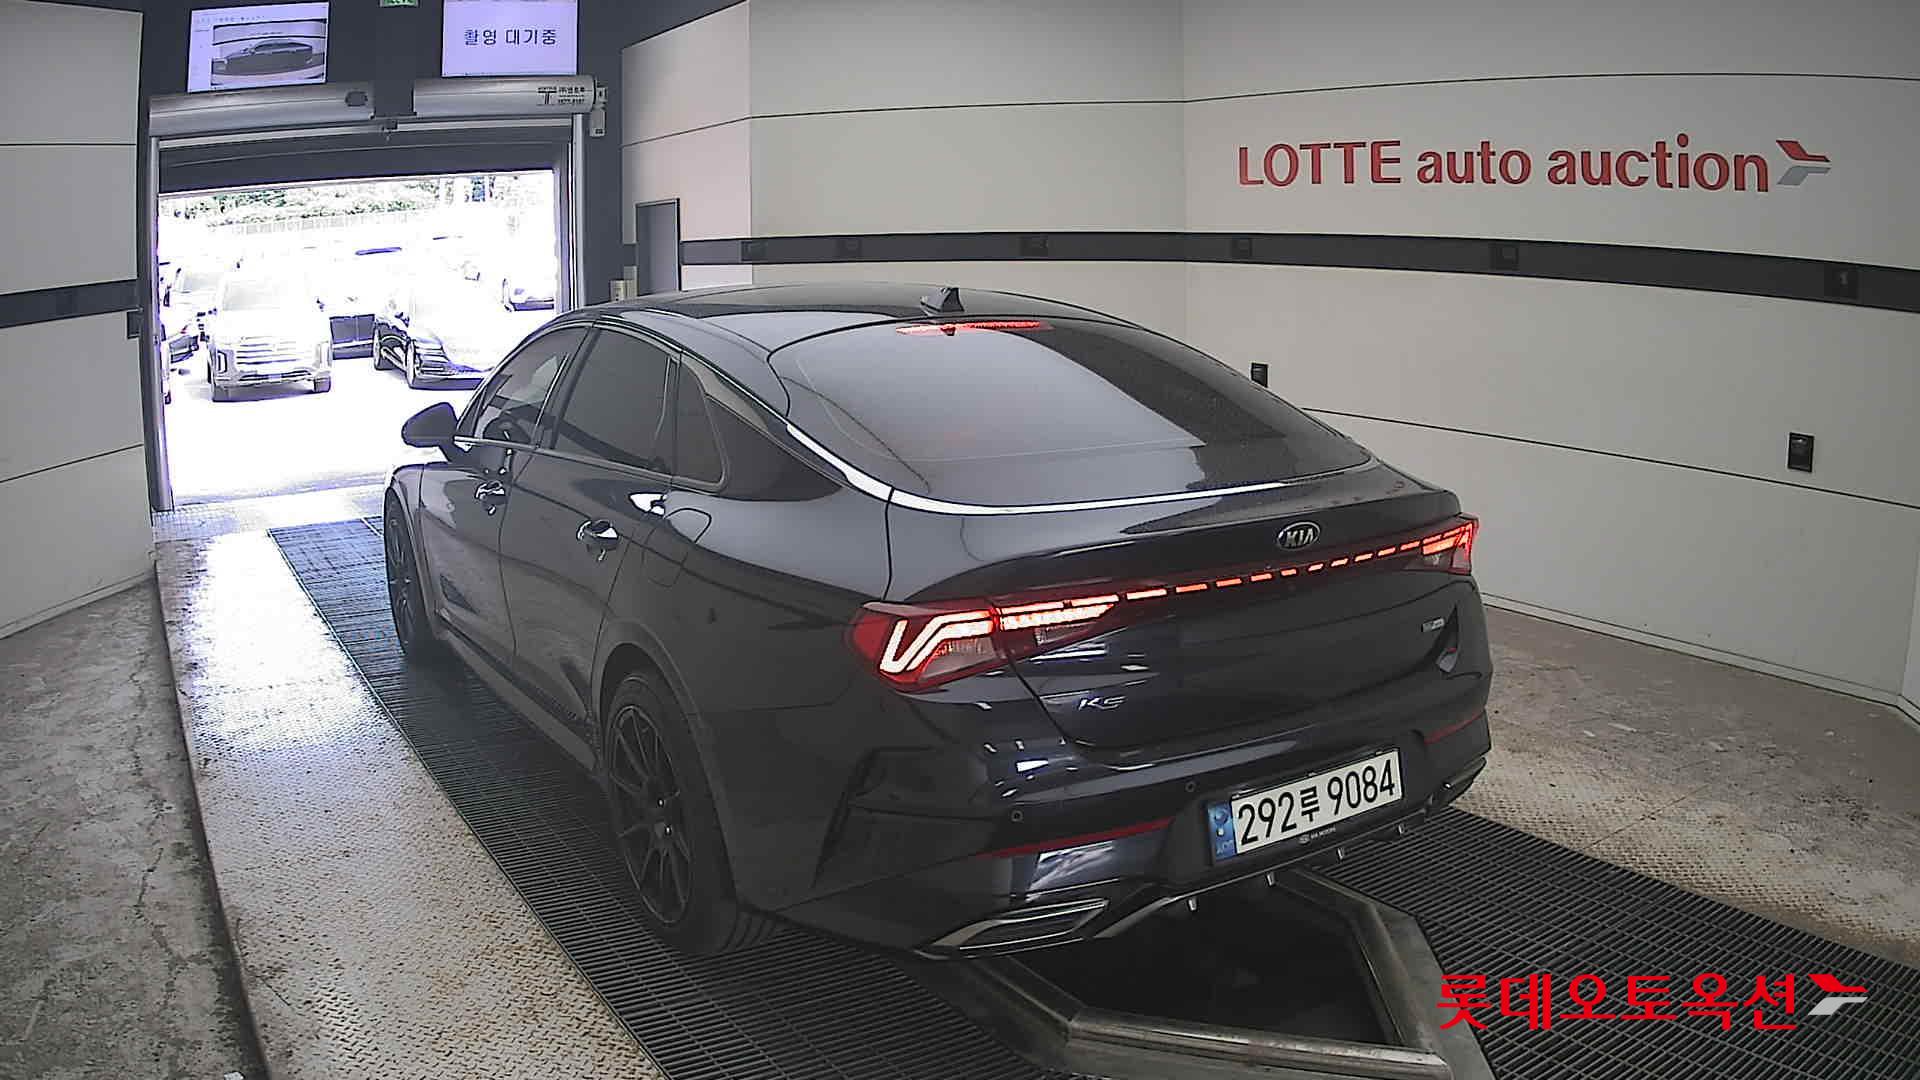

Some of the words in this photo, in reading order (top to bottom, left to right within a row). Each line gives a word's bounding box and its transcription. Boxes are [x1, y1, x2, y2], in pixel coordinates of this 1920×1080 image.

[465, 29, 497, 46] 촬영
[505, 29, 556, 46] 대기중
[1239, 140, 1401, 186] LOTTE
[1417, 141, 1531, 185] auto
[1548, 133, 1769, 192] auction
[1283, 526, 1315, 548] KIA
[1237, 785, 1320, 846] 292루
[1326, 759, 1396, 815] 9084
